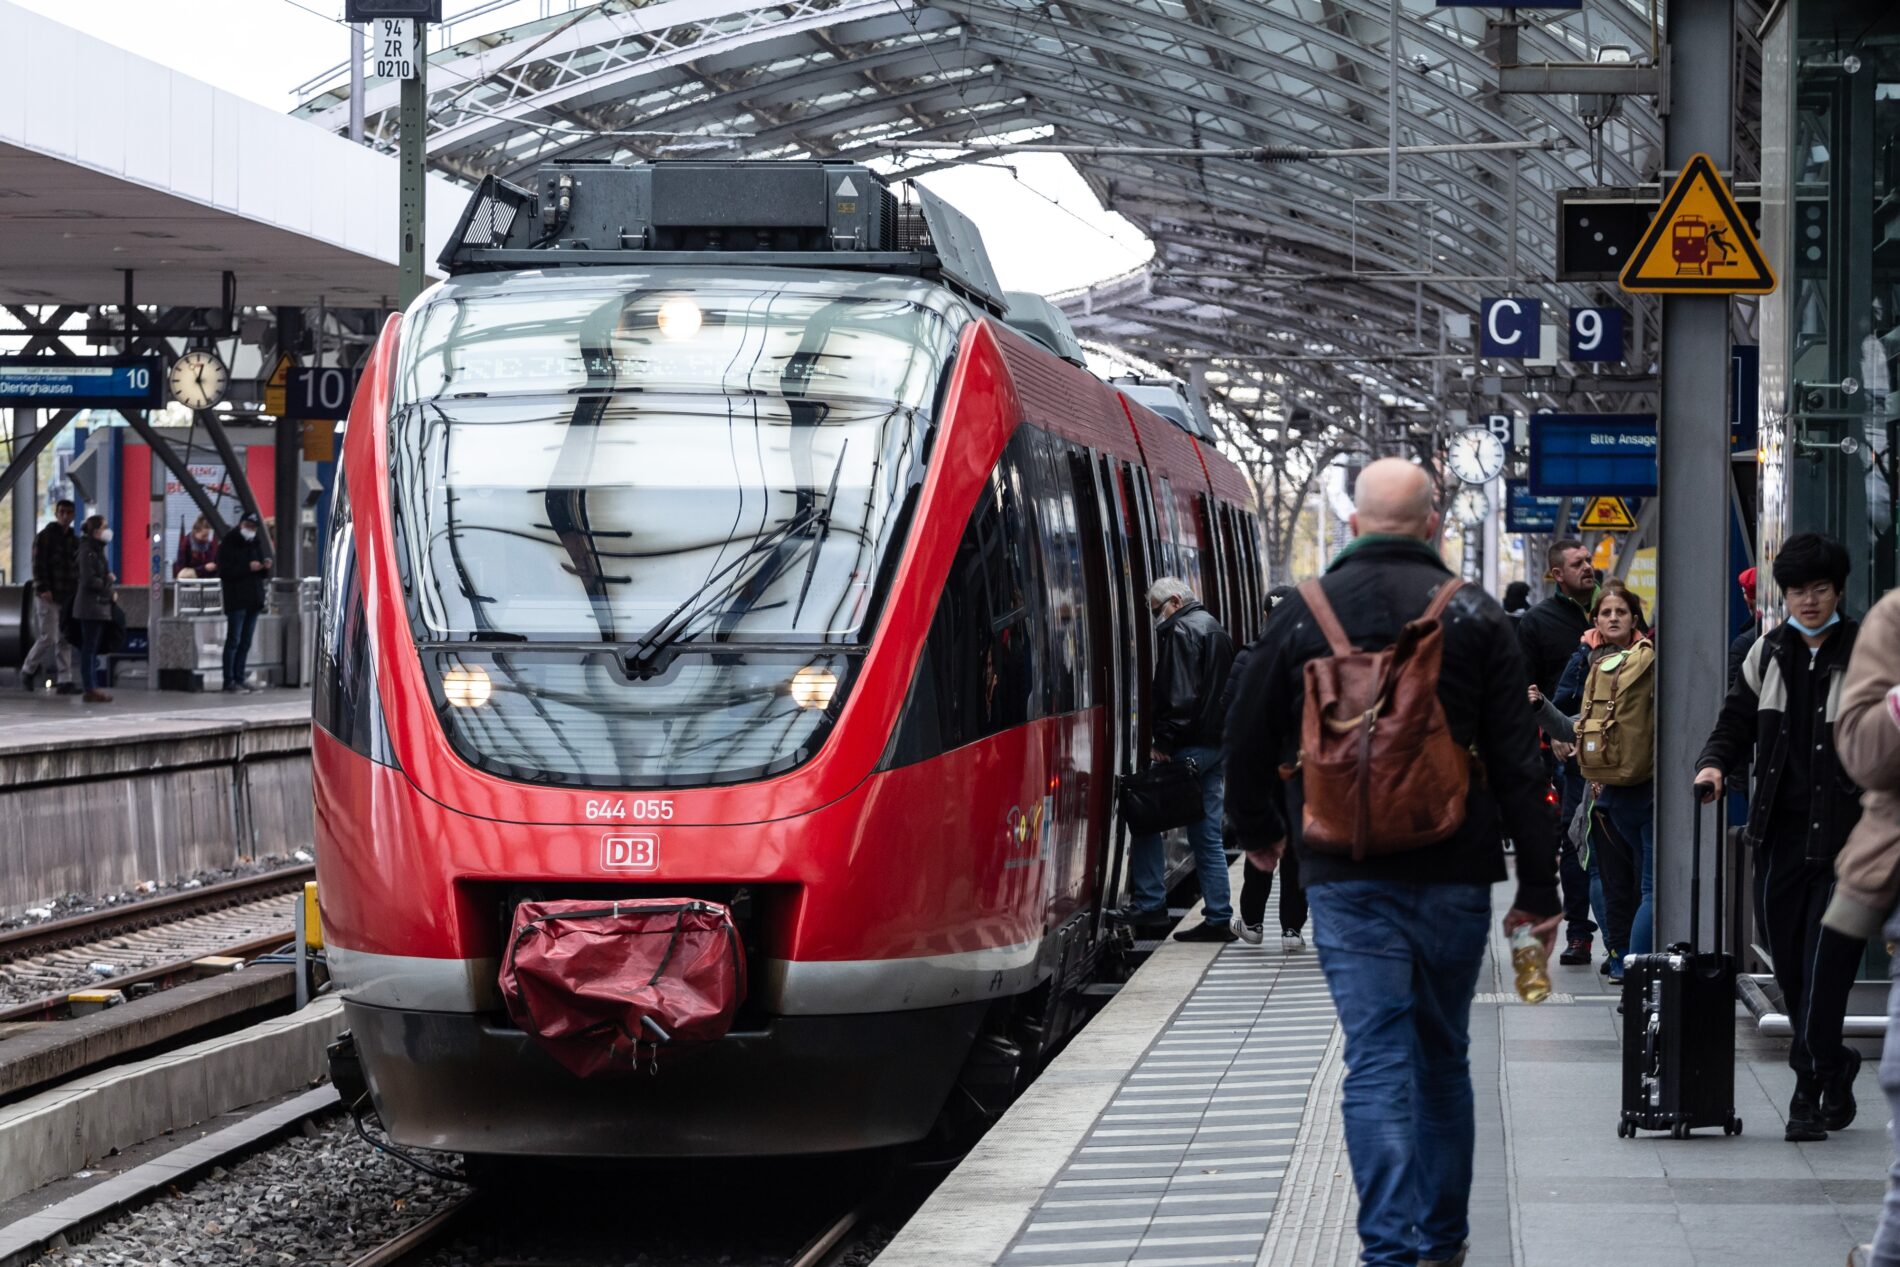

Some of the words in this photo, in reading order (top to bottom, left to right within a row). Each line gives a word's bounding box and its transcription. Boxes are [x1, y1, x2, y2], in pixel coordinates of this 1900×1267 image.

[384, 19, 402, 37] 94
[384, 40, 402, 57] ZR
[377, 60, 410, 78] 0210
[1488, 299, 1522, 345] C
[1575, 309, 1603, 350] 9
[0, 381, 74, 396] Dieringhausen
[126, 368, 149, 389] 10
[298, 369, 345, 409] 10
[1489, 415, 1511, 444] B
[1590, 433, 1616, 446] Bitte
[585, 799, 626, 819] 644
[633, 799, 674, 819] 055
[608, 840, 651, 865] DB
